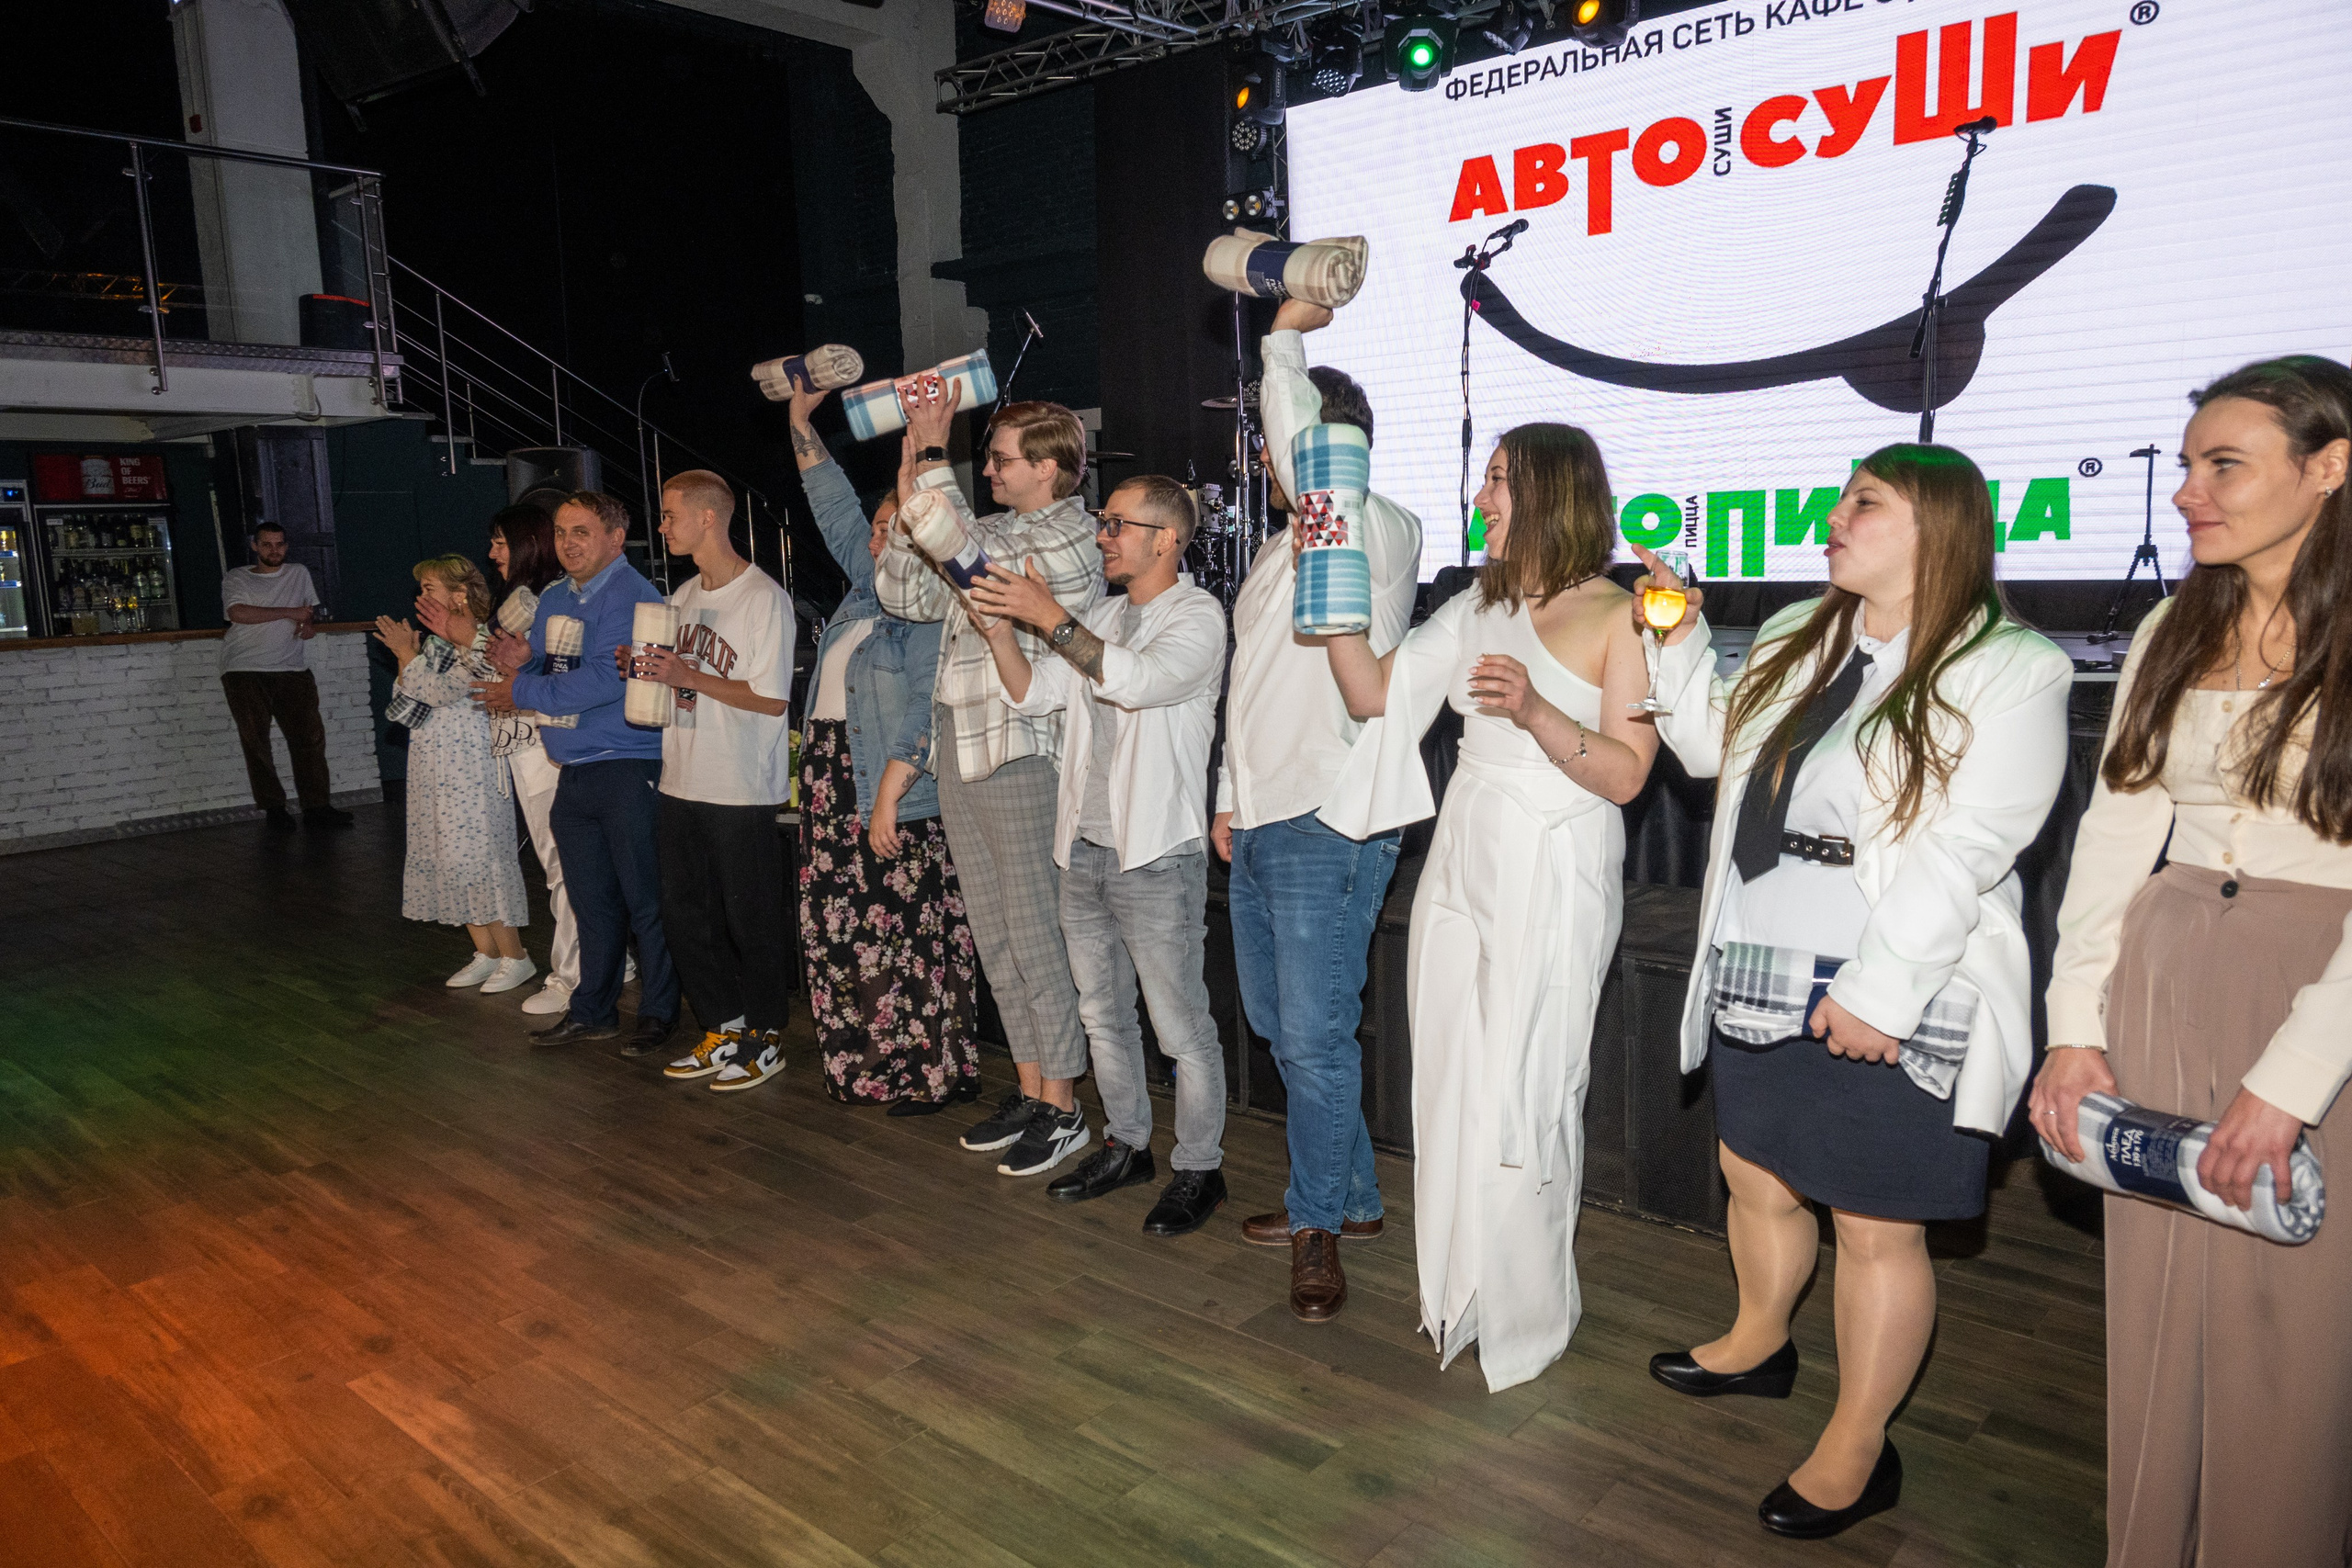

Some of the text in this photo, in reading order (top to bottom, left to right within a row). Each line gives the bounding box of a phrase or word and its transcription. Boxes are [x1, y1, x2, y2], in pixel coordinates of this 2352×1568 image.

[1445, 29, 1664, 101] ФЕДЕРАЛЬНАЯ
[1671, 9, 1756, 51] СЕТЬ
[1713, 107, 1733, 176] СУШИ
[1448, 117, 1707, 236] АВТО
[86, 477, 111, 489] Bud
[119, 457, 141, 467] KING
[120, 467, 132, 476] OF
[1685, 494, 1700, 548] ПИЦЦА
[2120, 1128, 2137, 1166] ПЛЕД
